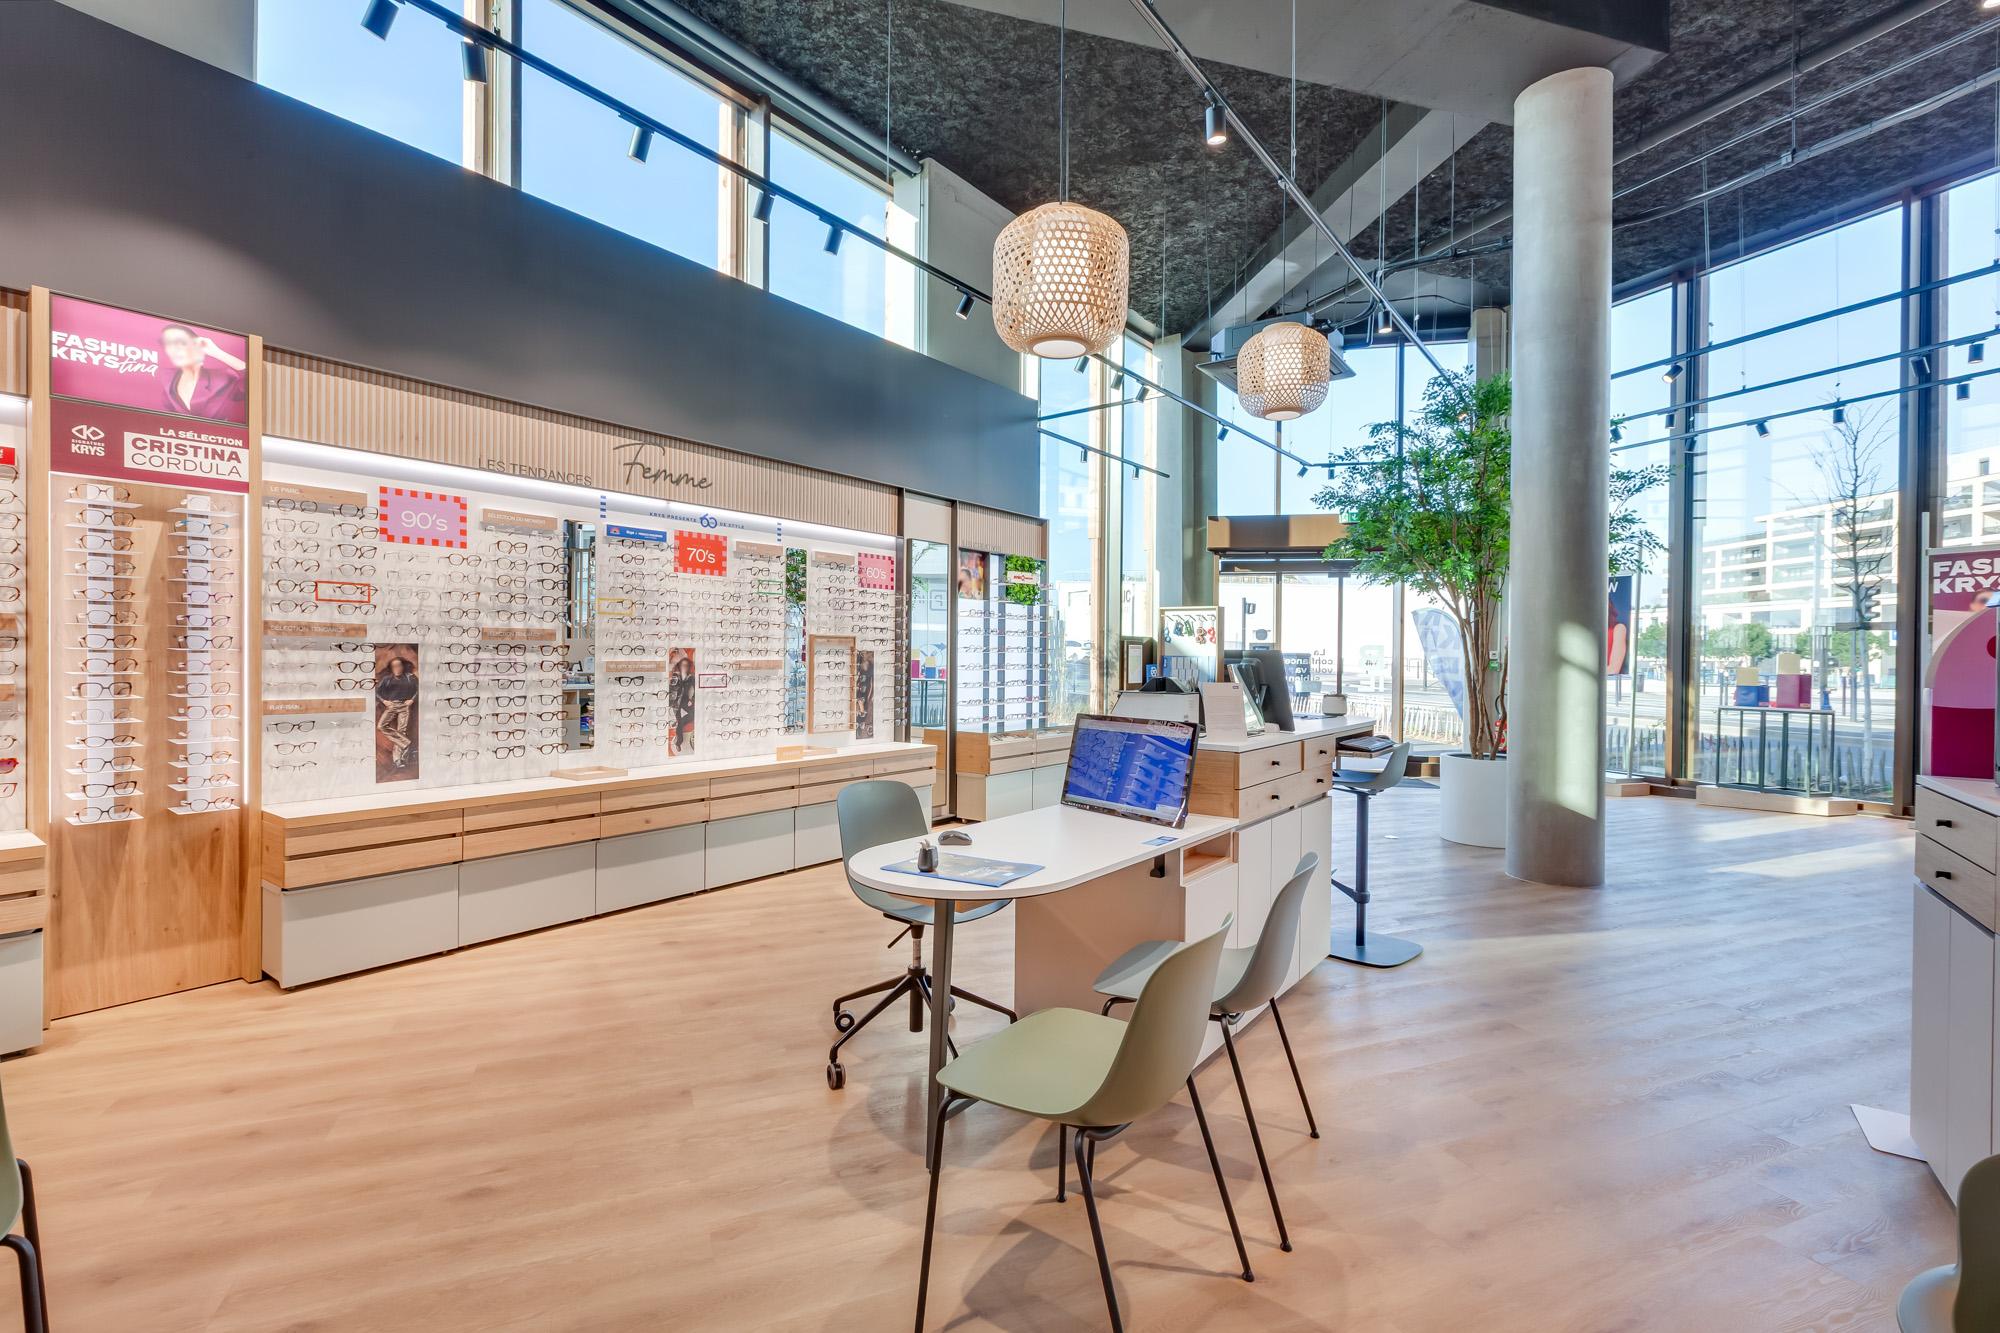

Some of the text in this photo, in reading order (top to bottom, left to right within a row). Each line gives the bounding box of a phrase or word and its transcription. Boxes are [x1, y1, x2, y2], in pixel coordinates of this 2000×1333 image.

[52, 330, 158, 363] FASHION
[159, 427, 243, 447] LA SÉLECTION
[71, 443, 105, 457] KRYS
[131, 437, 242, 464] CRISTINA
[131, 453, 242, 478] CORDULA
[478, 457, 592, 486] LES TENDANCES
[612, 442, 714, 490] Femme
[400, 510, 449, 532] 90's
[686, 547, 716, 564] 70's
[865, 566, 888, 580] 60's
[1933, 575, 2000, 594] KRY
